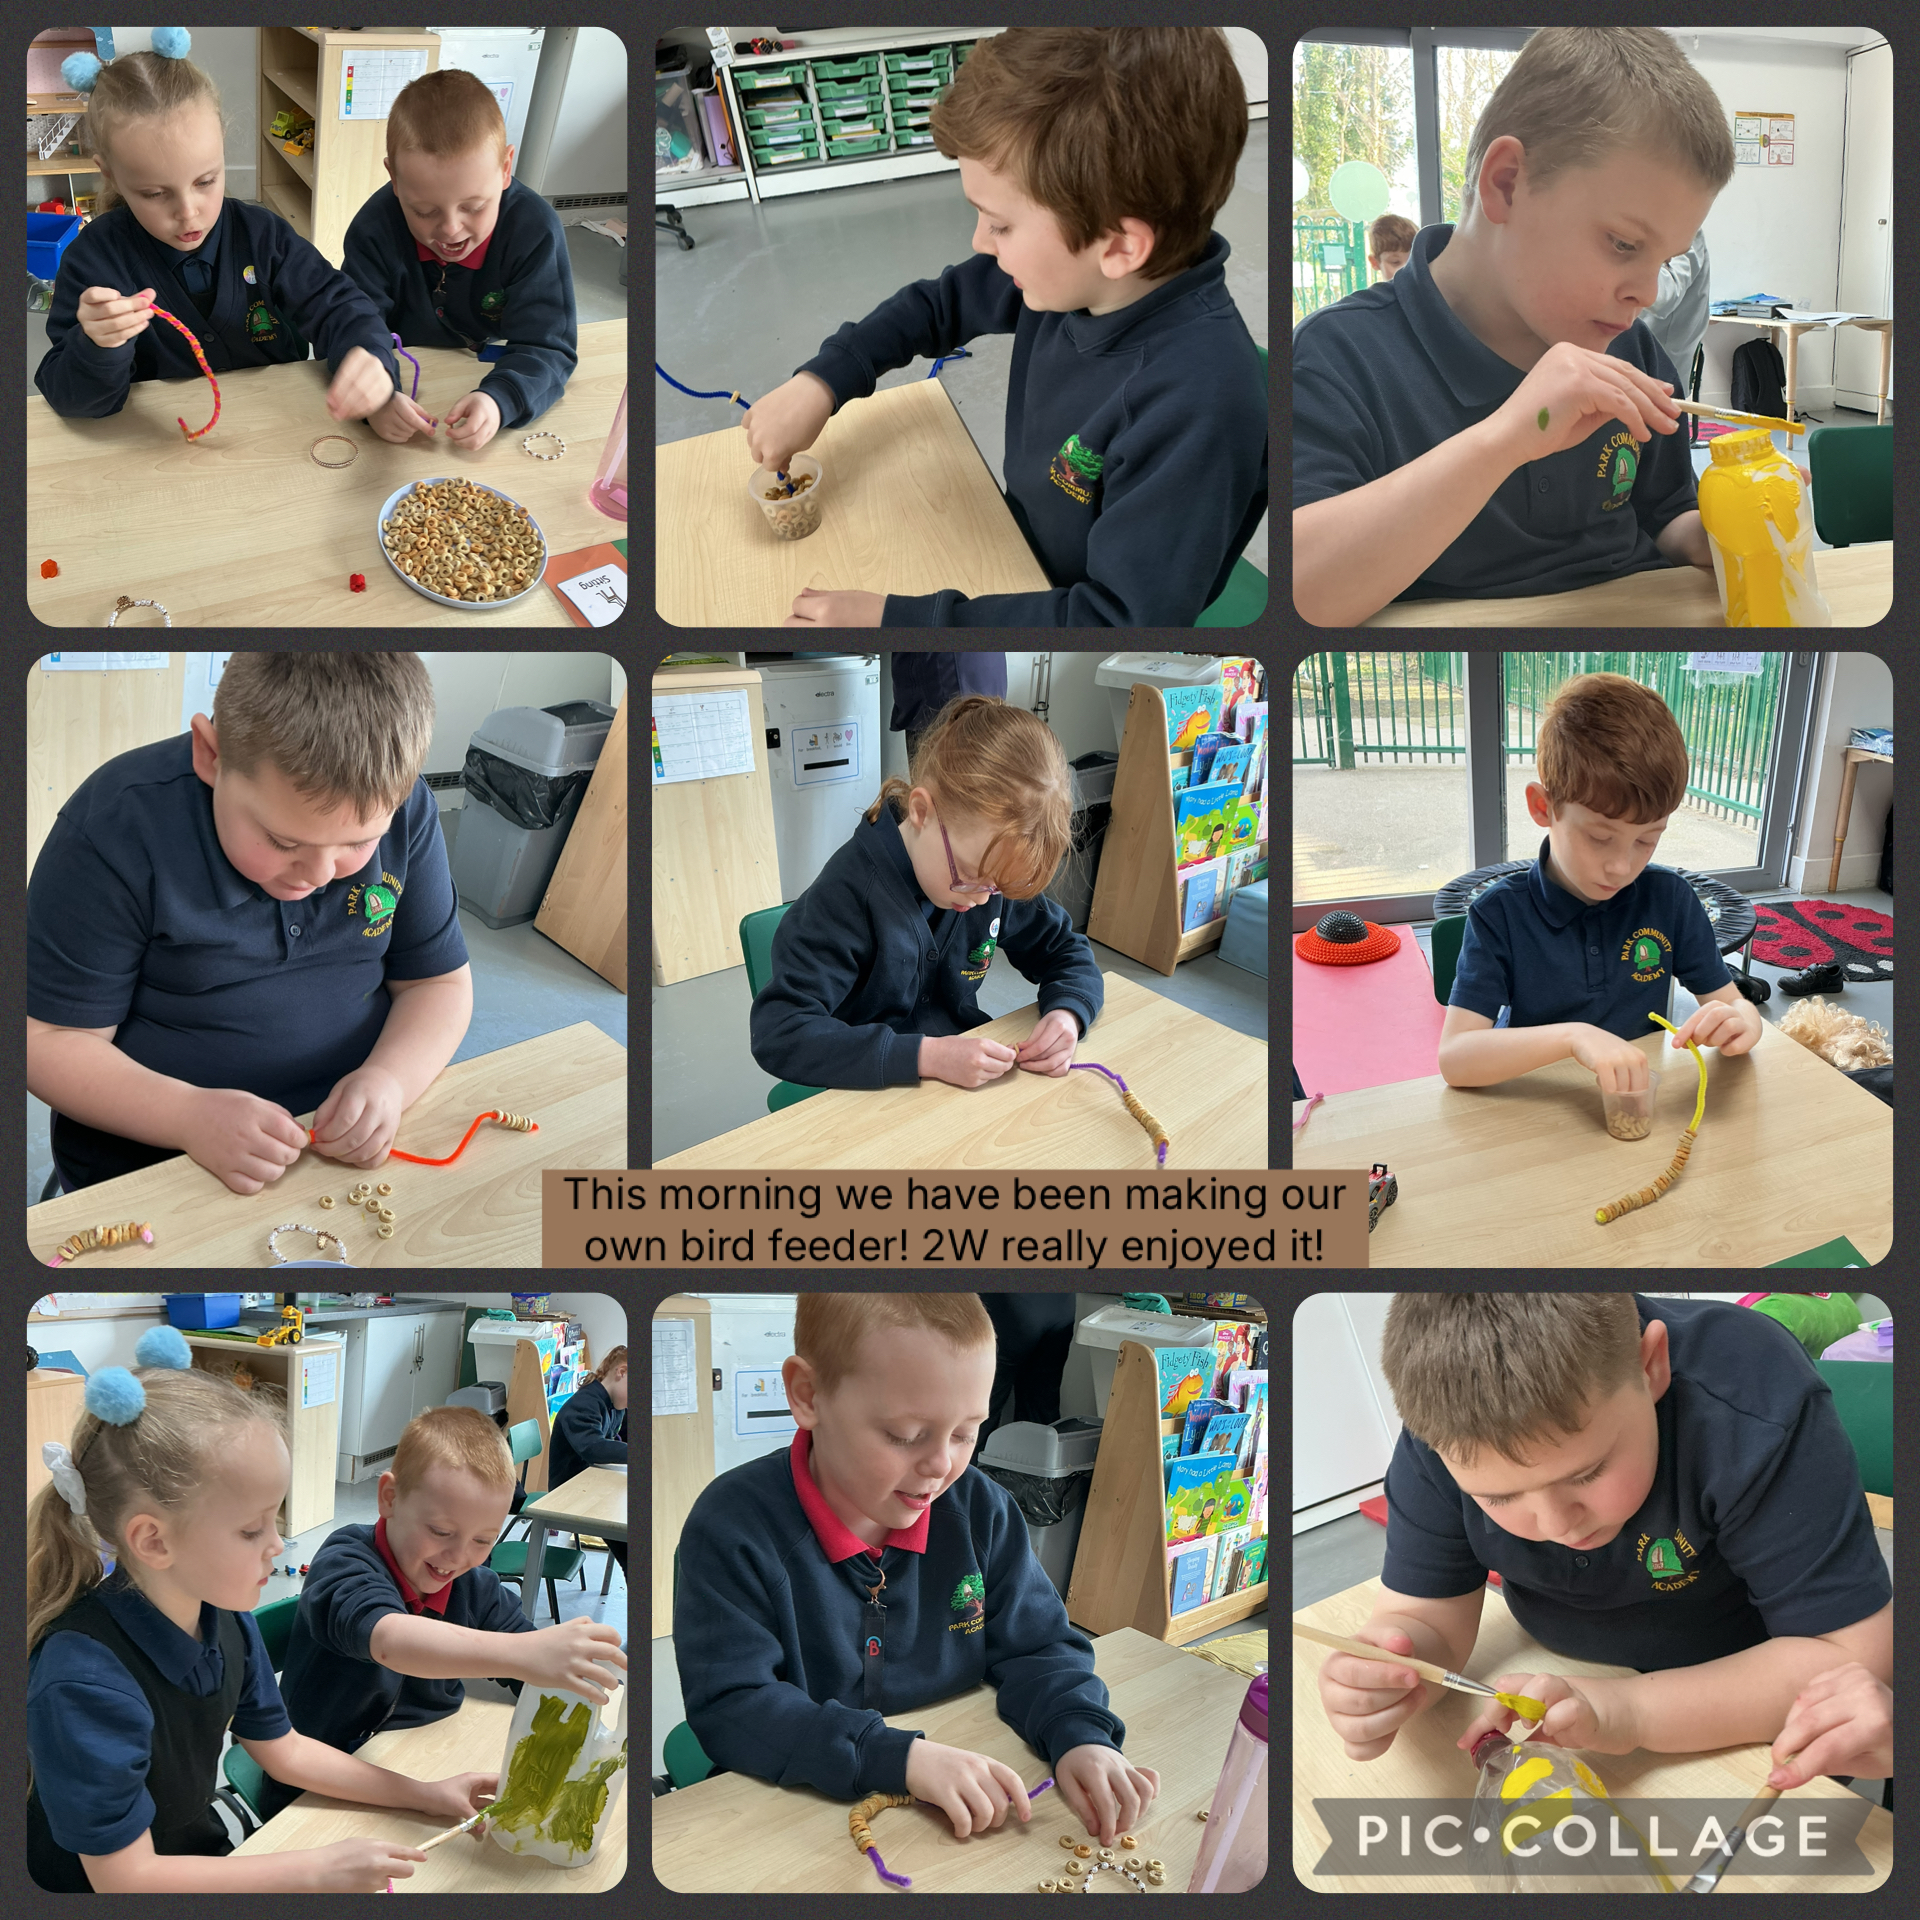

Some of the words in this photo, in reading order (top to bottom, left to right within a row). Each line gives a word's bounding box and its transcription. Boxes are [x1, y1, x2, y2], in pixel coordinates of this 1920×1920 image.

[1596, 443, 1613, 478] PARK
[578, 574, 611, 590] Sitting
[1170, 690, 1198, 708] Fidgety
[1198, 688, 1216, 705] Fish
[347, 885, 361, 916] PARK
[1621, 938, 1634, 961] PARK
[1632, 927, 1672, 952] COMMUNITY
[1631, 967, 1666, 982] ACADEMY
[1161, 1352, 1191, 1371] Fidgety
[1191, 1350, 1210, 1368] Fish
[1176, 1465, 1188, 1475] Mary
[1188, 1468, 1198, 1477] had
[1218, 1461, 1232, 1470] Lamb
[1637, 1533, 1650, 1562] PARK
[1651, 1570, 1700, 1591] ACADEMY
[948, 1621, 970, 1632] PARK
[869, 1640, 880, 1657] B
